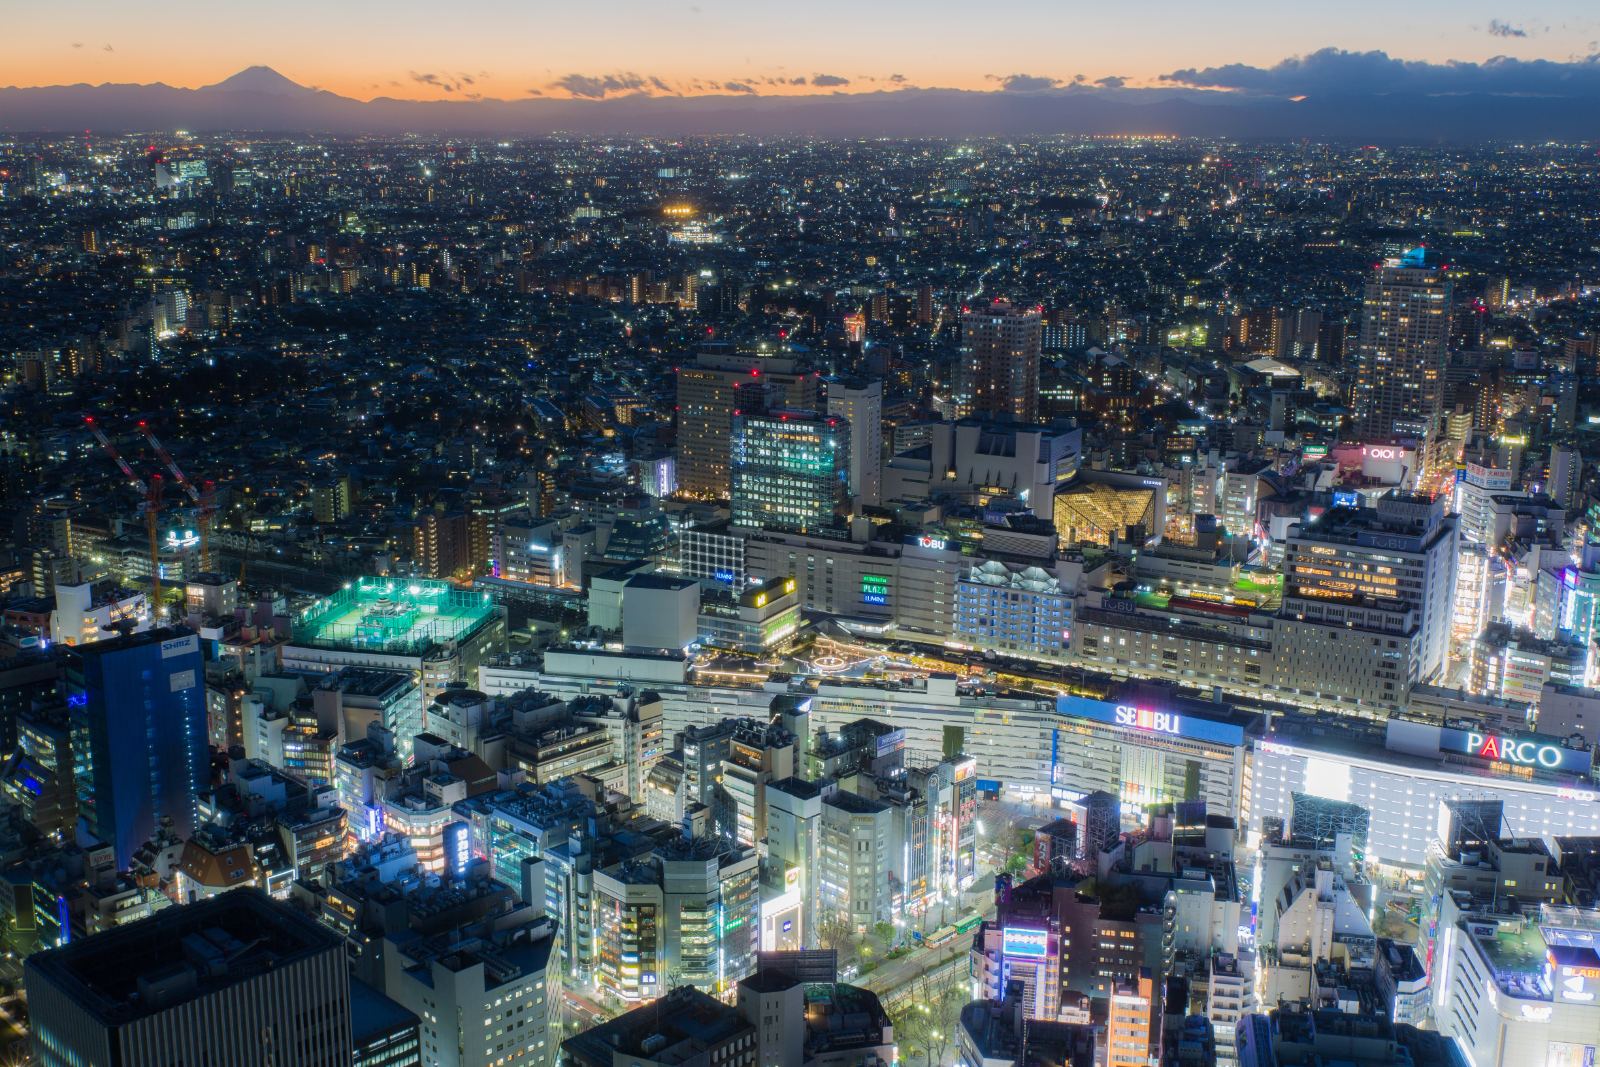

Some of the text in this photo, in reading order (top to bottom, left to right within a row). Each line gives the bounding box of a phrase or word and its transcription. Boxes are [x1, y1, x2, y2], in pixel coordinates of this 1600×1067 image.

[918, 537, 945, 550] TOBU
[1371, 536, 1407, 549] TOBU
[863, 584, 888, 594] PLAZA
[1103, 599, 1134, 612] TOBU
[1115, 705, 1180, 734] SEIBU
[1466, 732, 1563, 767] PARCO
